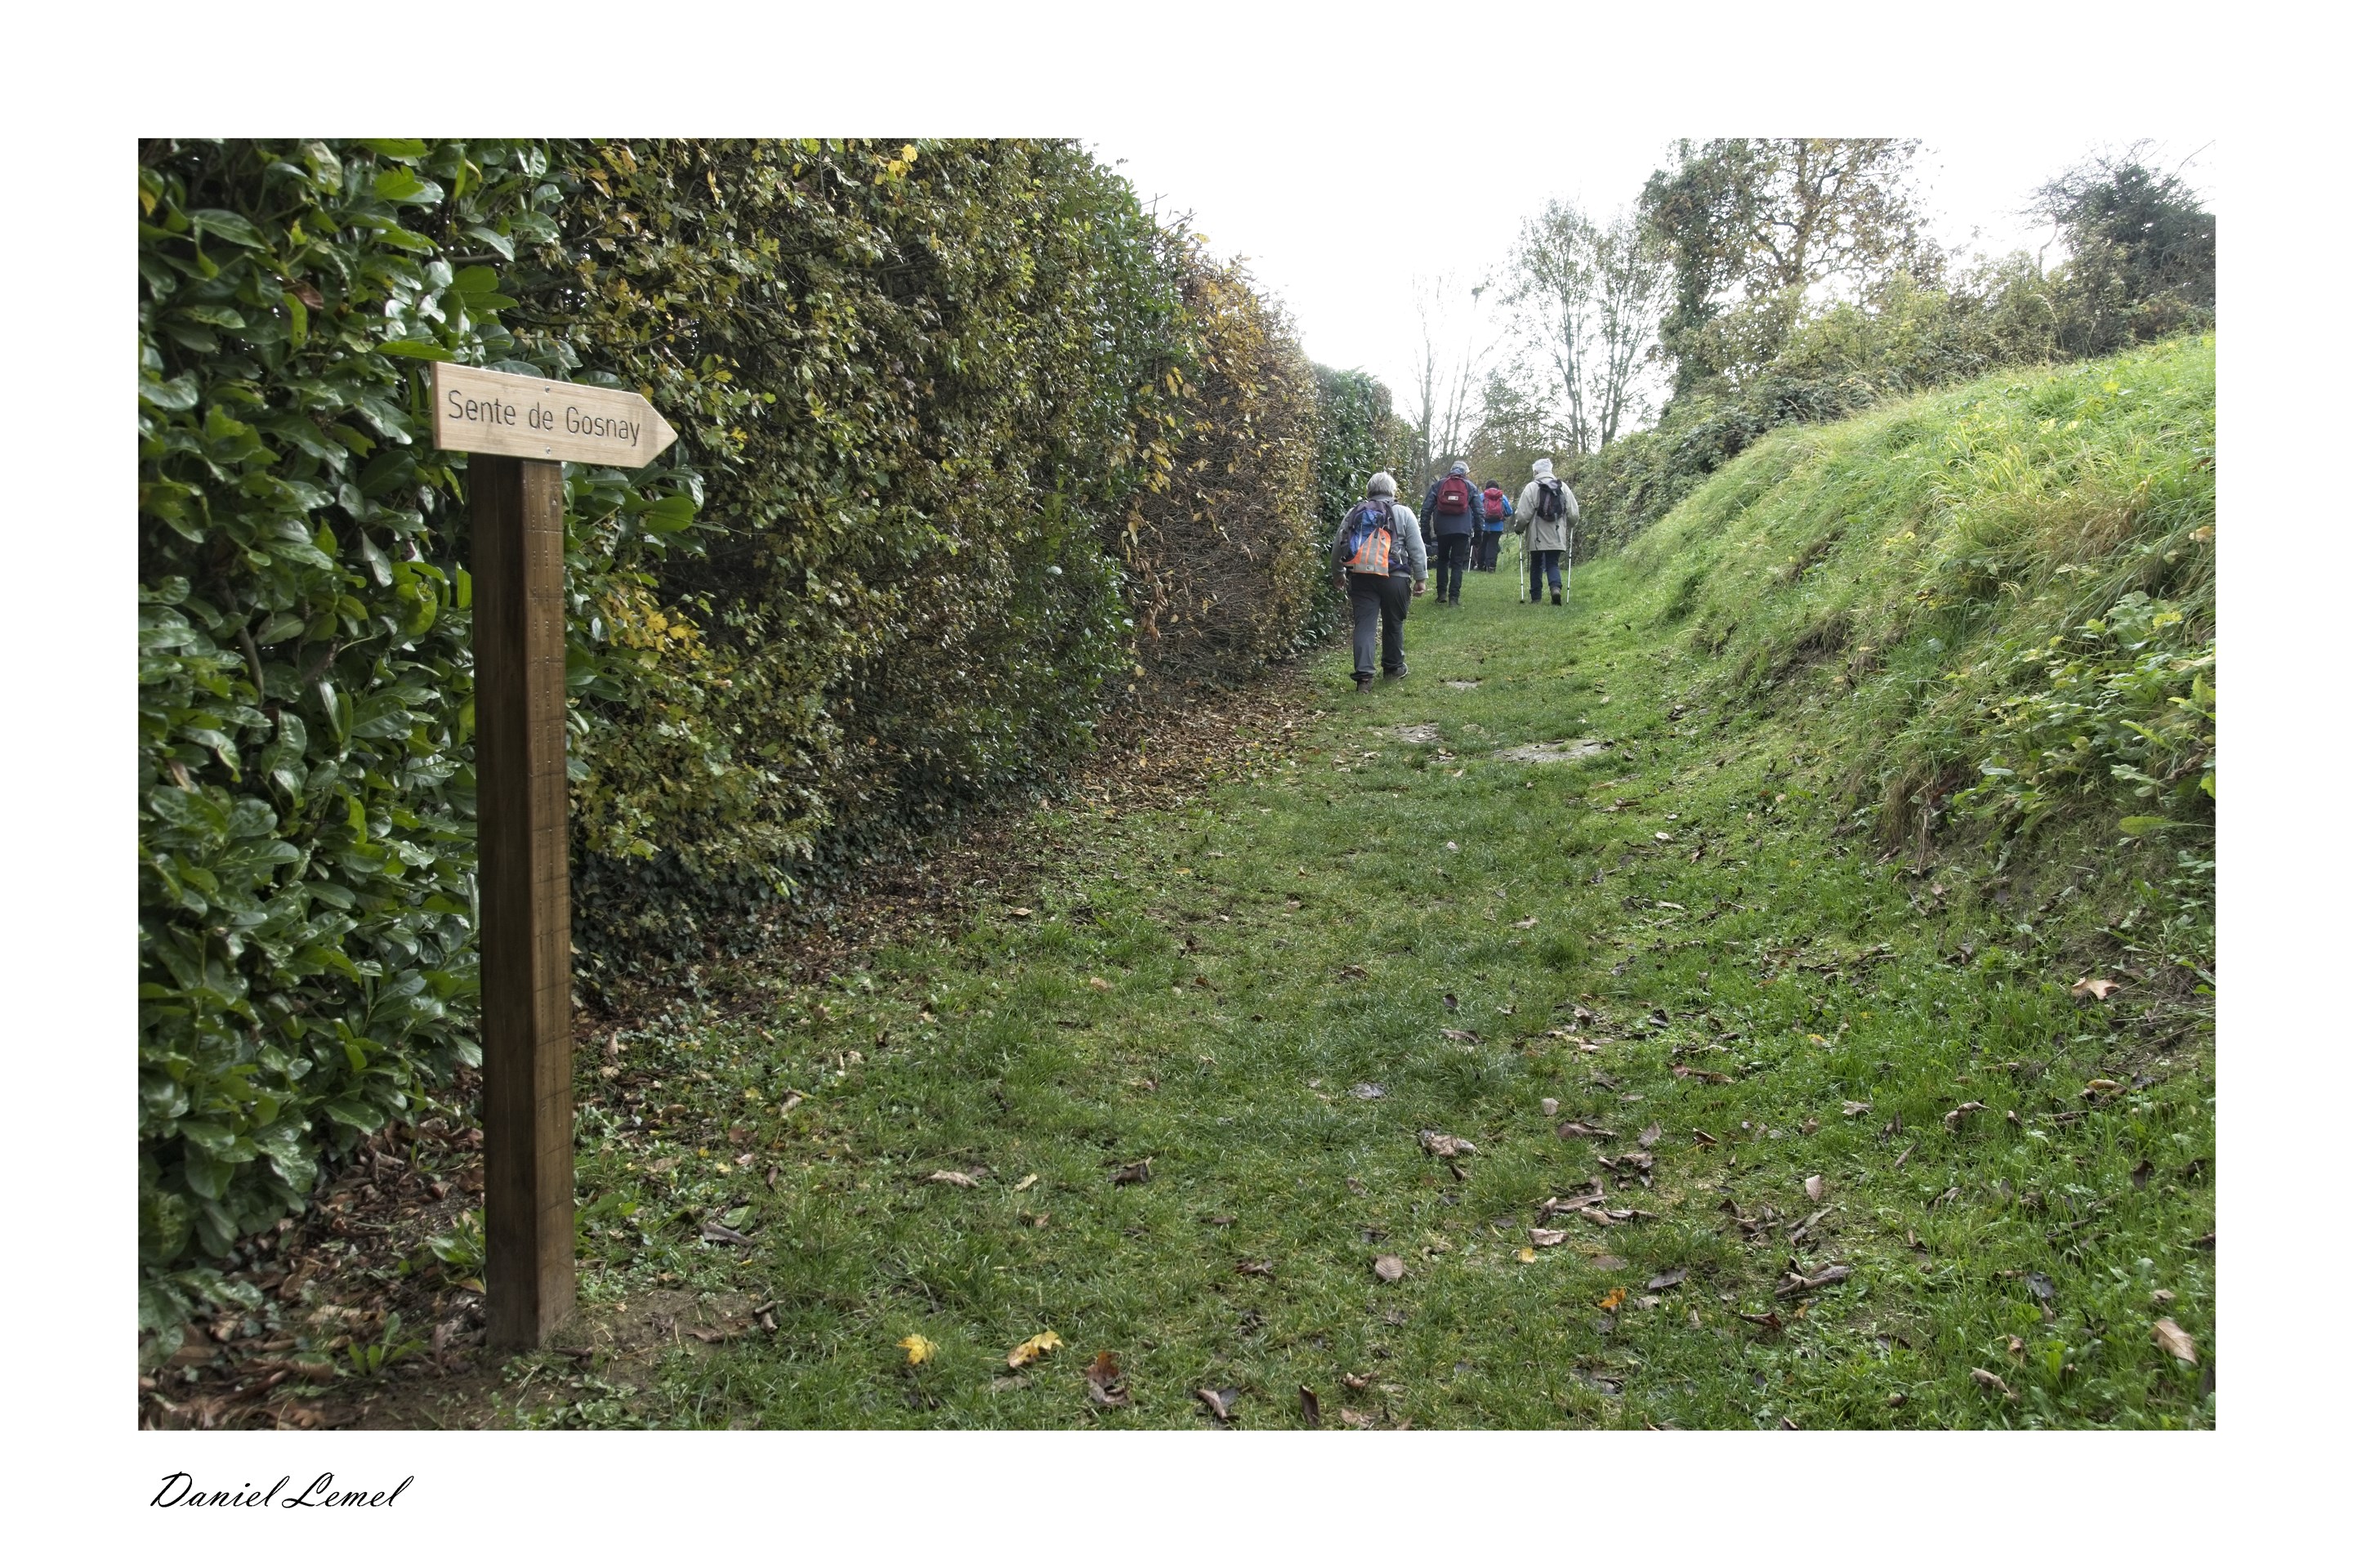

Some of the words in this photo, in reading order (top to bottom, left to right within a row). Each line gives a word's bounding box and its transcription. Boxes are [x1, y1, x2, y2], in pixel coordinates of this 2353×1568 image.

[448, 390, 516, 426] Sente
[528, 402, 554, 431] de
[565, 406, 640, 446] Gosnay
